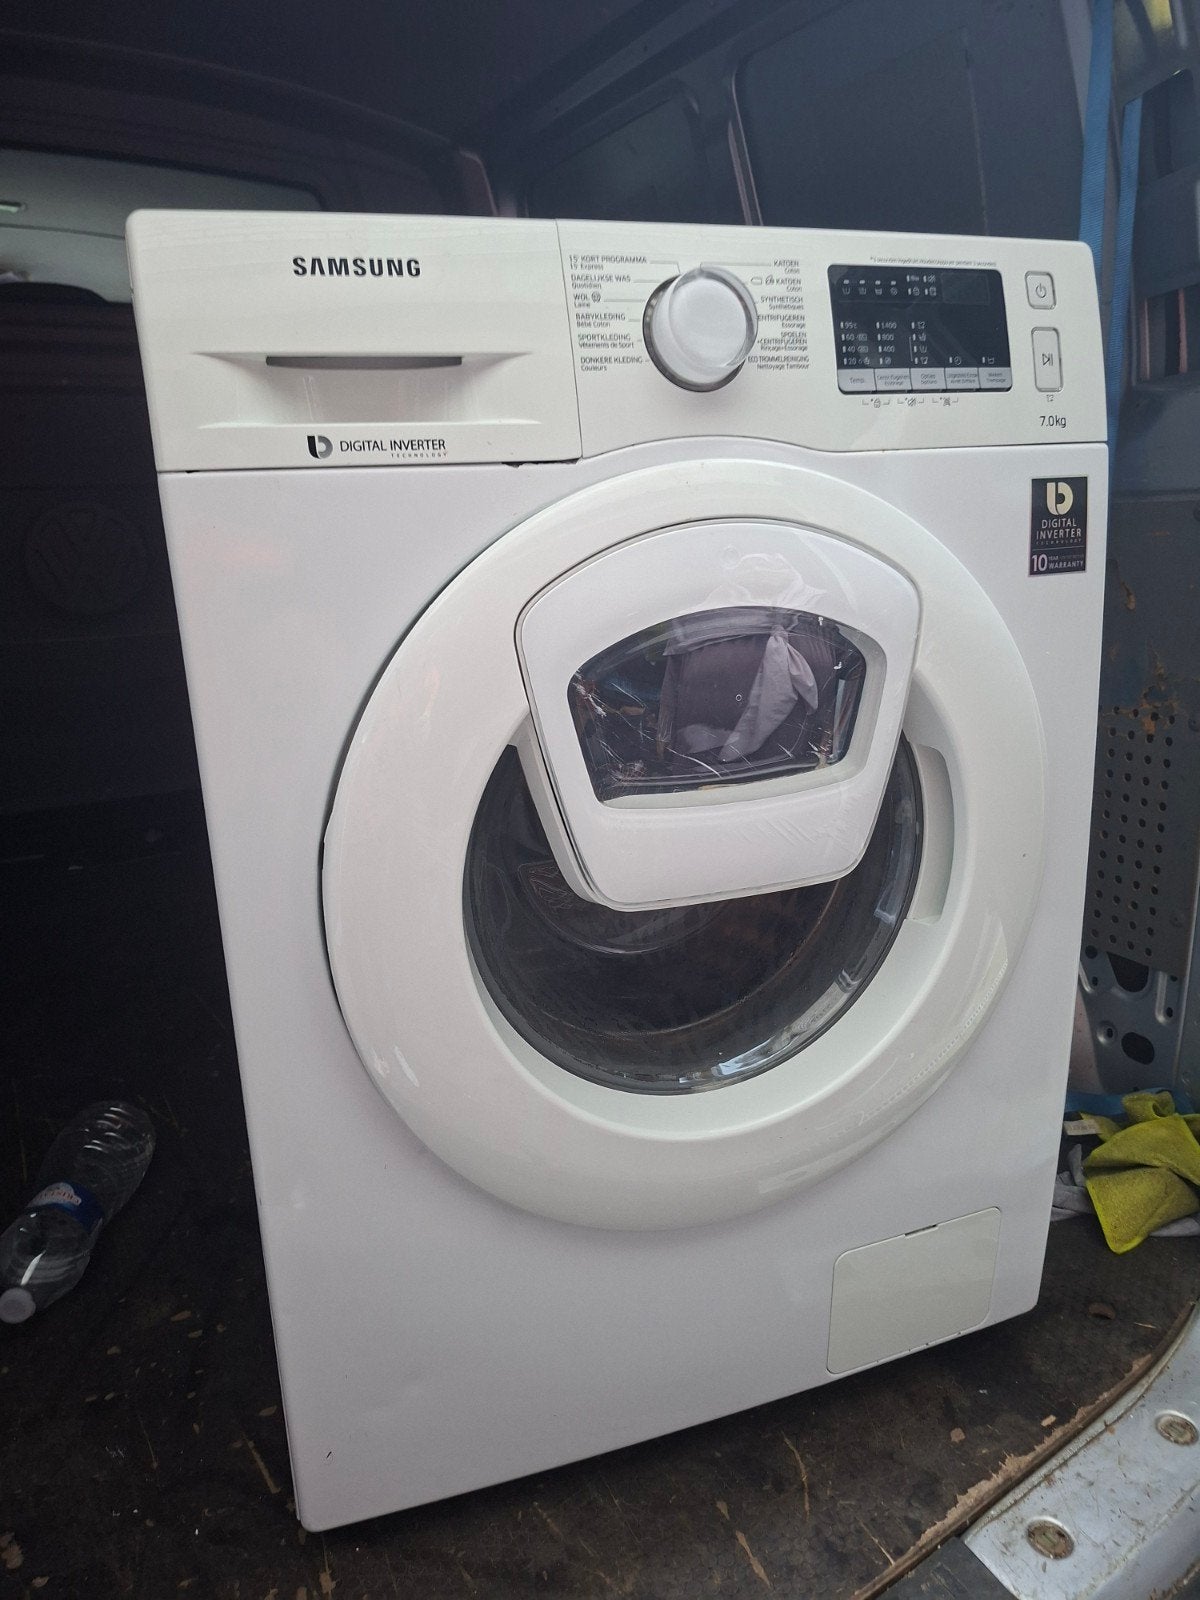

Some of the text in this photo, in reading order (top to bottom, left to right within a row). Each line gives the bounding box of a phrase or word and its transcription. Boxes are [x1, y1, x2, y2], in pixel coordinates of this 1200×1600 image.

[581, 255, 599, 263] KORT
[293, 257, 421, 277] SAMSUNG
[1040, 415, 1067, 428] 7.0kg
[340, 439, 446, 452] DIGITAL INVERTER
[1041, 518, 1077, 529] DIGITAL
[1036, 528, 1082, 539] INVERTER
[1032, 554, 1048, 572] 10
[1049, 561, 1083, 569] WARRANTY
